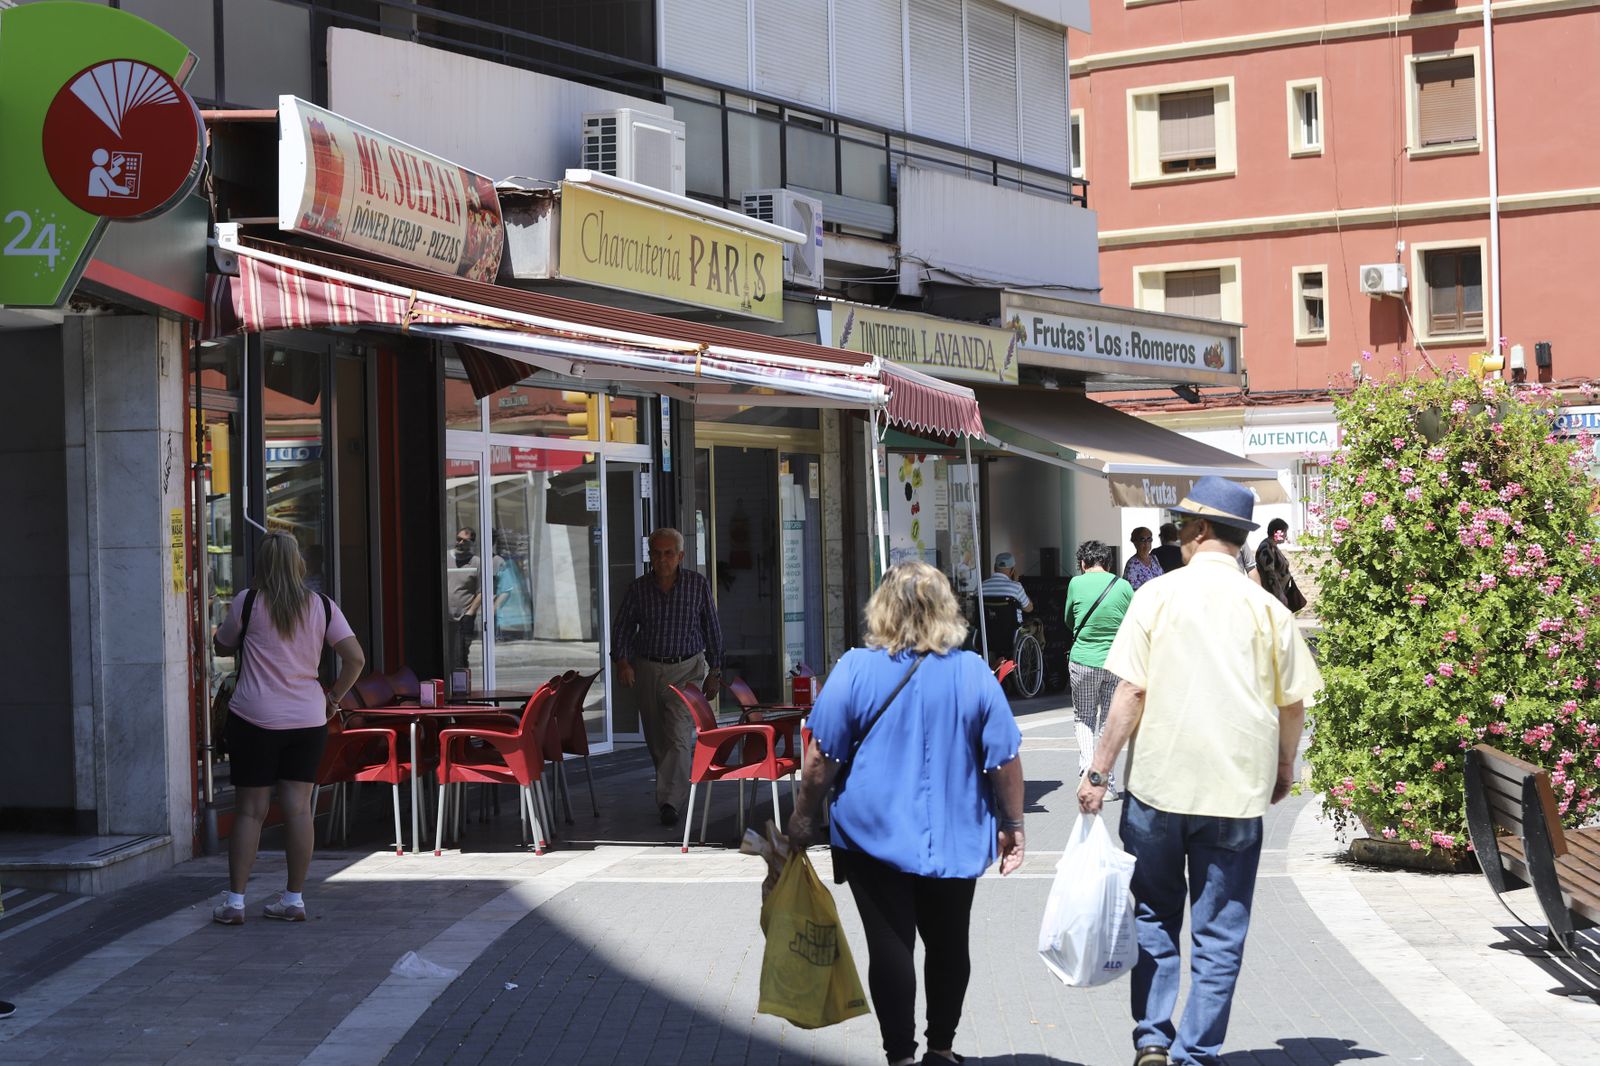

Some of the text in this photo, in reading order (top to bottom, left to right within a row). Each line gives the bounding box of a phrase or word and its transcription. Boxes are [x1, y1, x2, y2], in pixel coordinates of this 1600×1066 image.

[388, 145, 461, 228] SULTAN
[4, 210, 60, 268] 24
[351, 200, 391, 243] DÖNER
[389, 217, 422, 253] KEBAP
[427, 230, 461, 265] PIZZAS
[581, 209, 681, 283] Charcutería
[859, 321, 997, 373] TINTORERIA LAVANDA
[1033, 317, 1196, 365] Frutas Los Romeros
[1249, 430, 1328, 447] AUTENTICA
